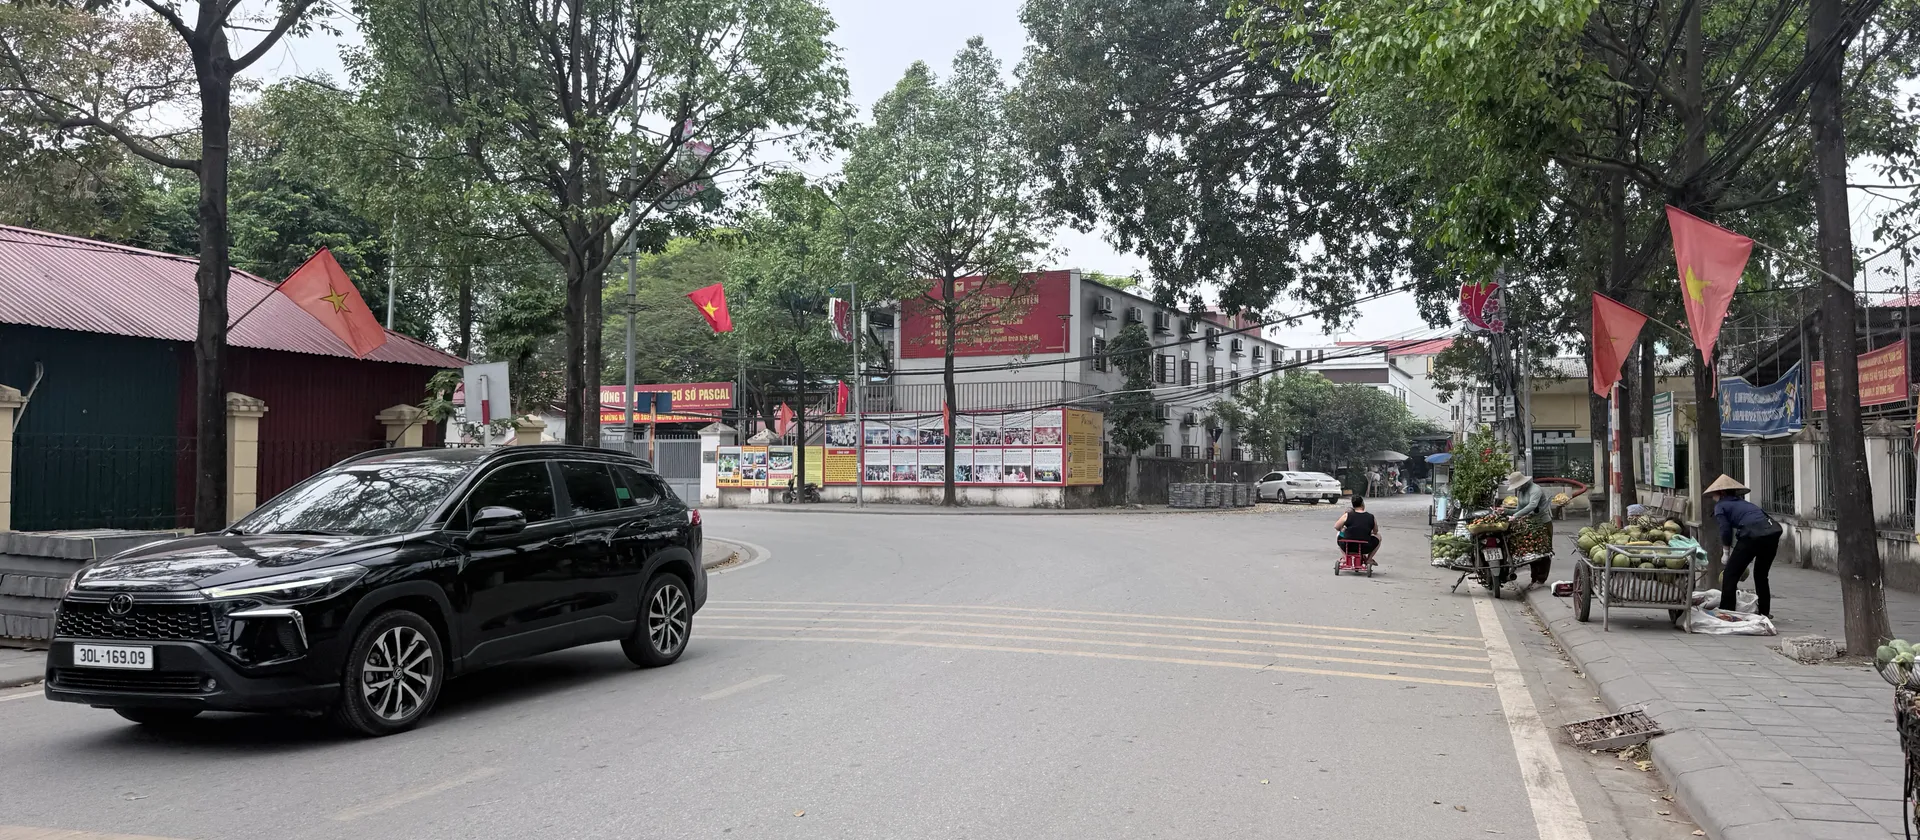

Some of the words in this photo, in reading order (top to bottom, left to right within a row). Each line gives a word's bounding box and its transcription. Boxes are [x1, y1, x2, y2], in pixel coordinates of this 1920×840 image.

[600, 389, 620, 404] ƯỜNG
[672, 388, 683, 401] CƠ
[685, 387, 697, 401] SỞ
[699, 388, 730, 401] PASCAL
[79, 648, 146, 664] 30L-169.09
